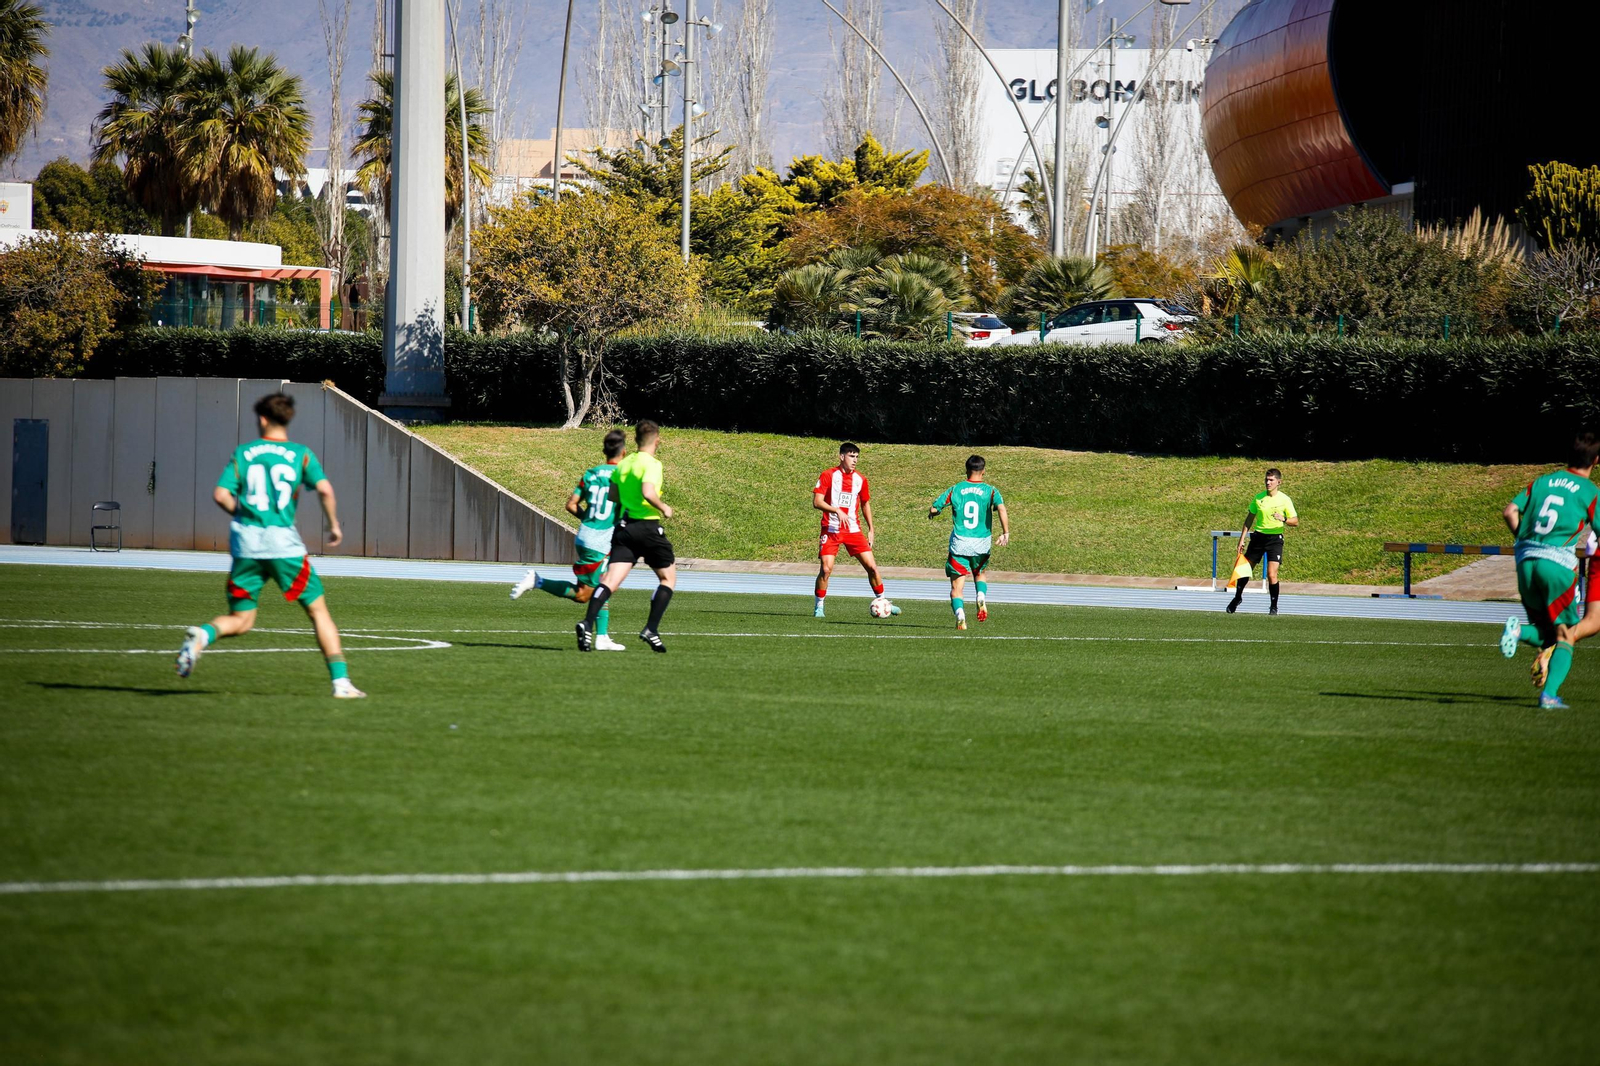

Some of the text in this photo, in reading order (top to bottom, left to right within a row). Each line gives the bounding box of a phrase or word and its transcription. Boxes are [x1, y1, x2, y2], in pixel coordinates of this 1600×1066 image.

[588, 485, 614, 521] 10
[963, 500, 979, 529] 9
[1534, 494, 1565, 535] 5
